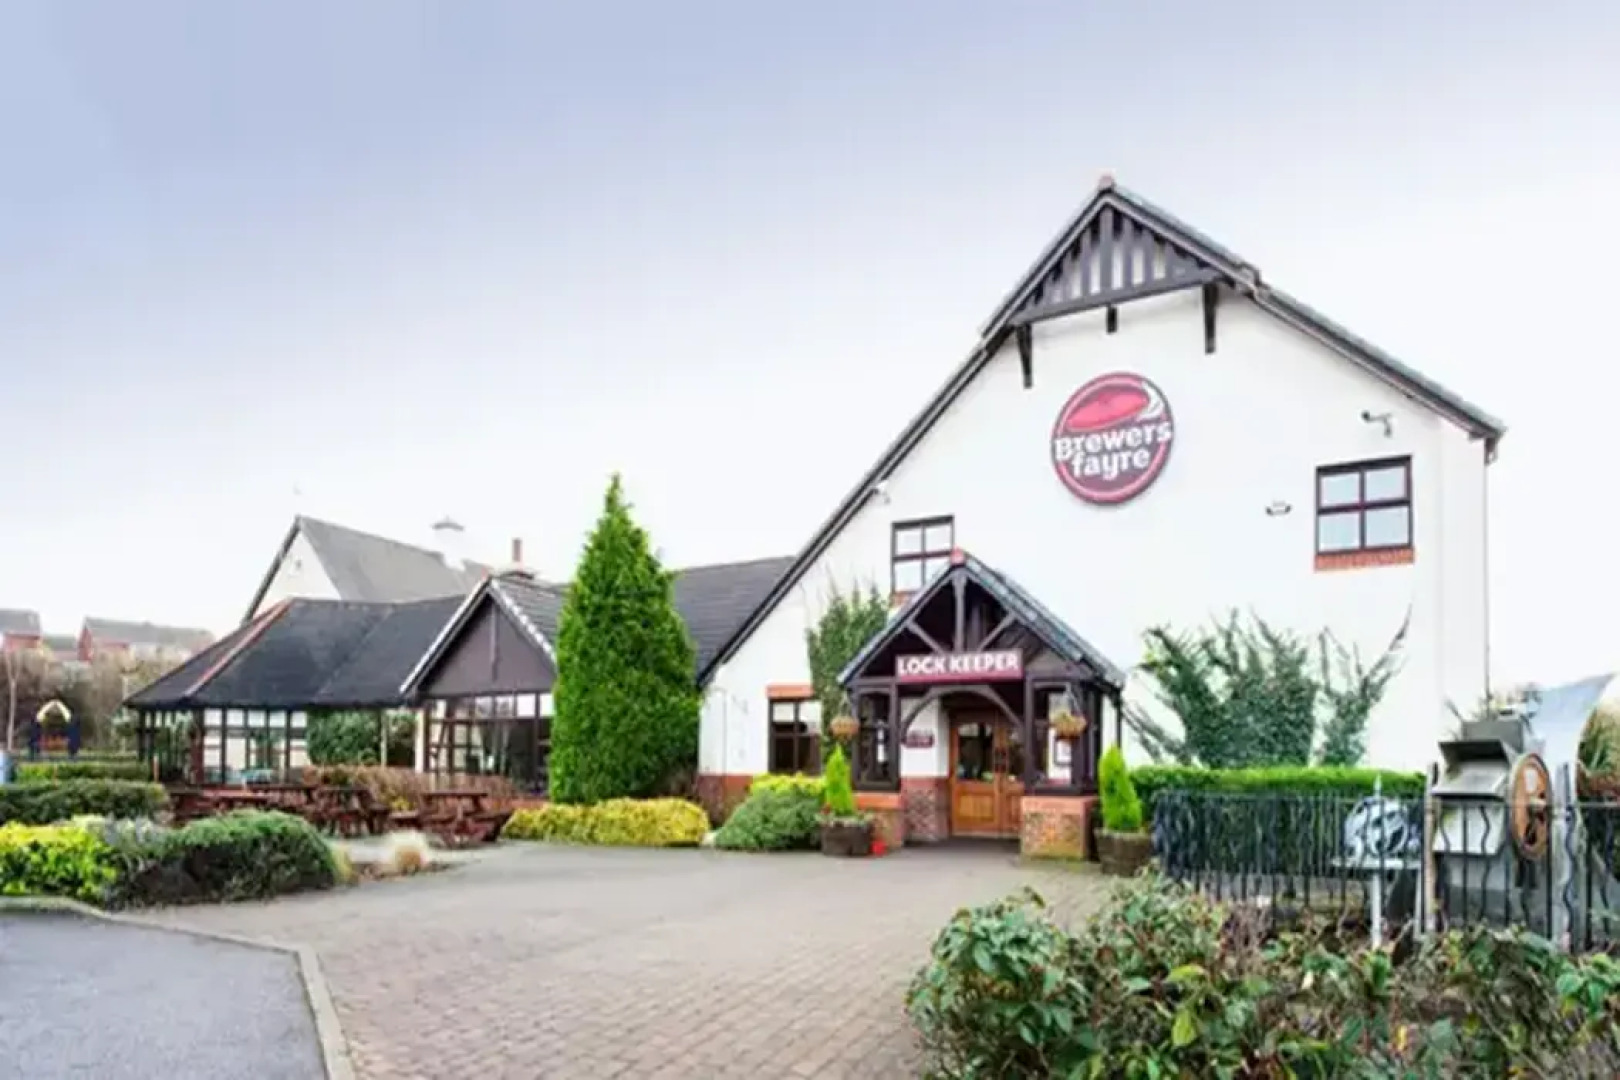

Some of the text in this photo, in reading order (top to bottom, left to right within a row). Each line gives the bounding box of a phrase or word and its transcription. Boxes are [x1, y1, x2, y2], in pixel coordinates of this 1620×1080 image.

[1055, 421, 1171, 461] Brewers
[1071, 449, 1150, 480] fayre
[897, 652, 1019, 675] LOCK KEEPER
